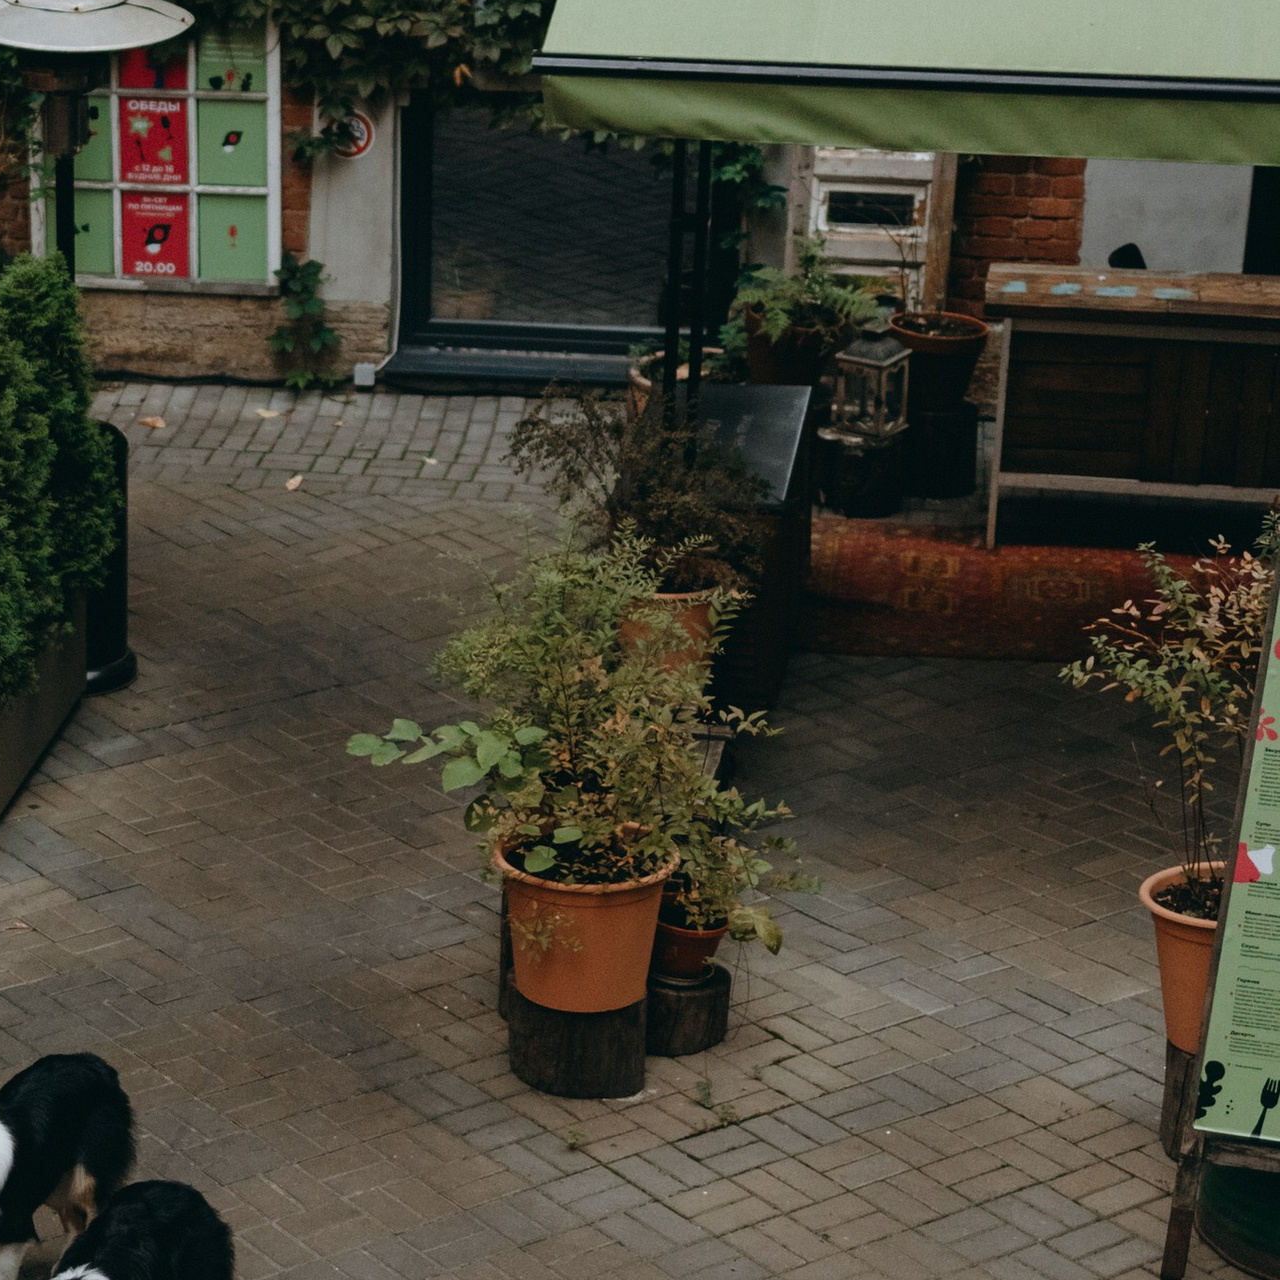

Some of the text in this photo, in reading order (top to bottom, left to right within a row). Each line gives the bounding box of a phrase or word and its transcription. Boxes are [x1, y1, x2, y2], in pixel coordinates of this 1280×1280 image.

[128, 100, 180, 113] ОБЕДЫ
[142, 164, 151, 172] 12
[152, 165, 164, 173] до
[134, 261, 176, 274] 20.00
